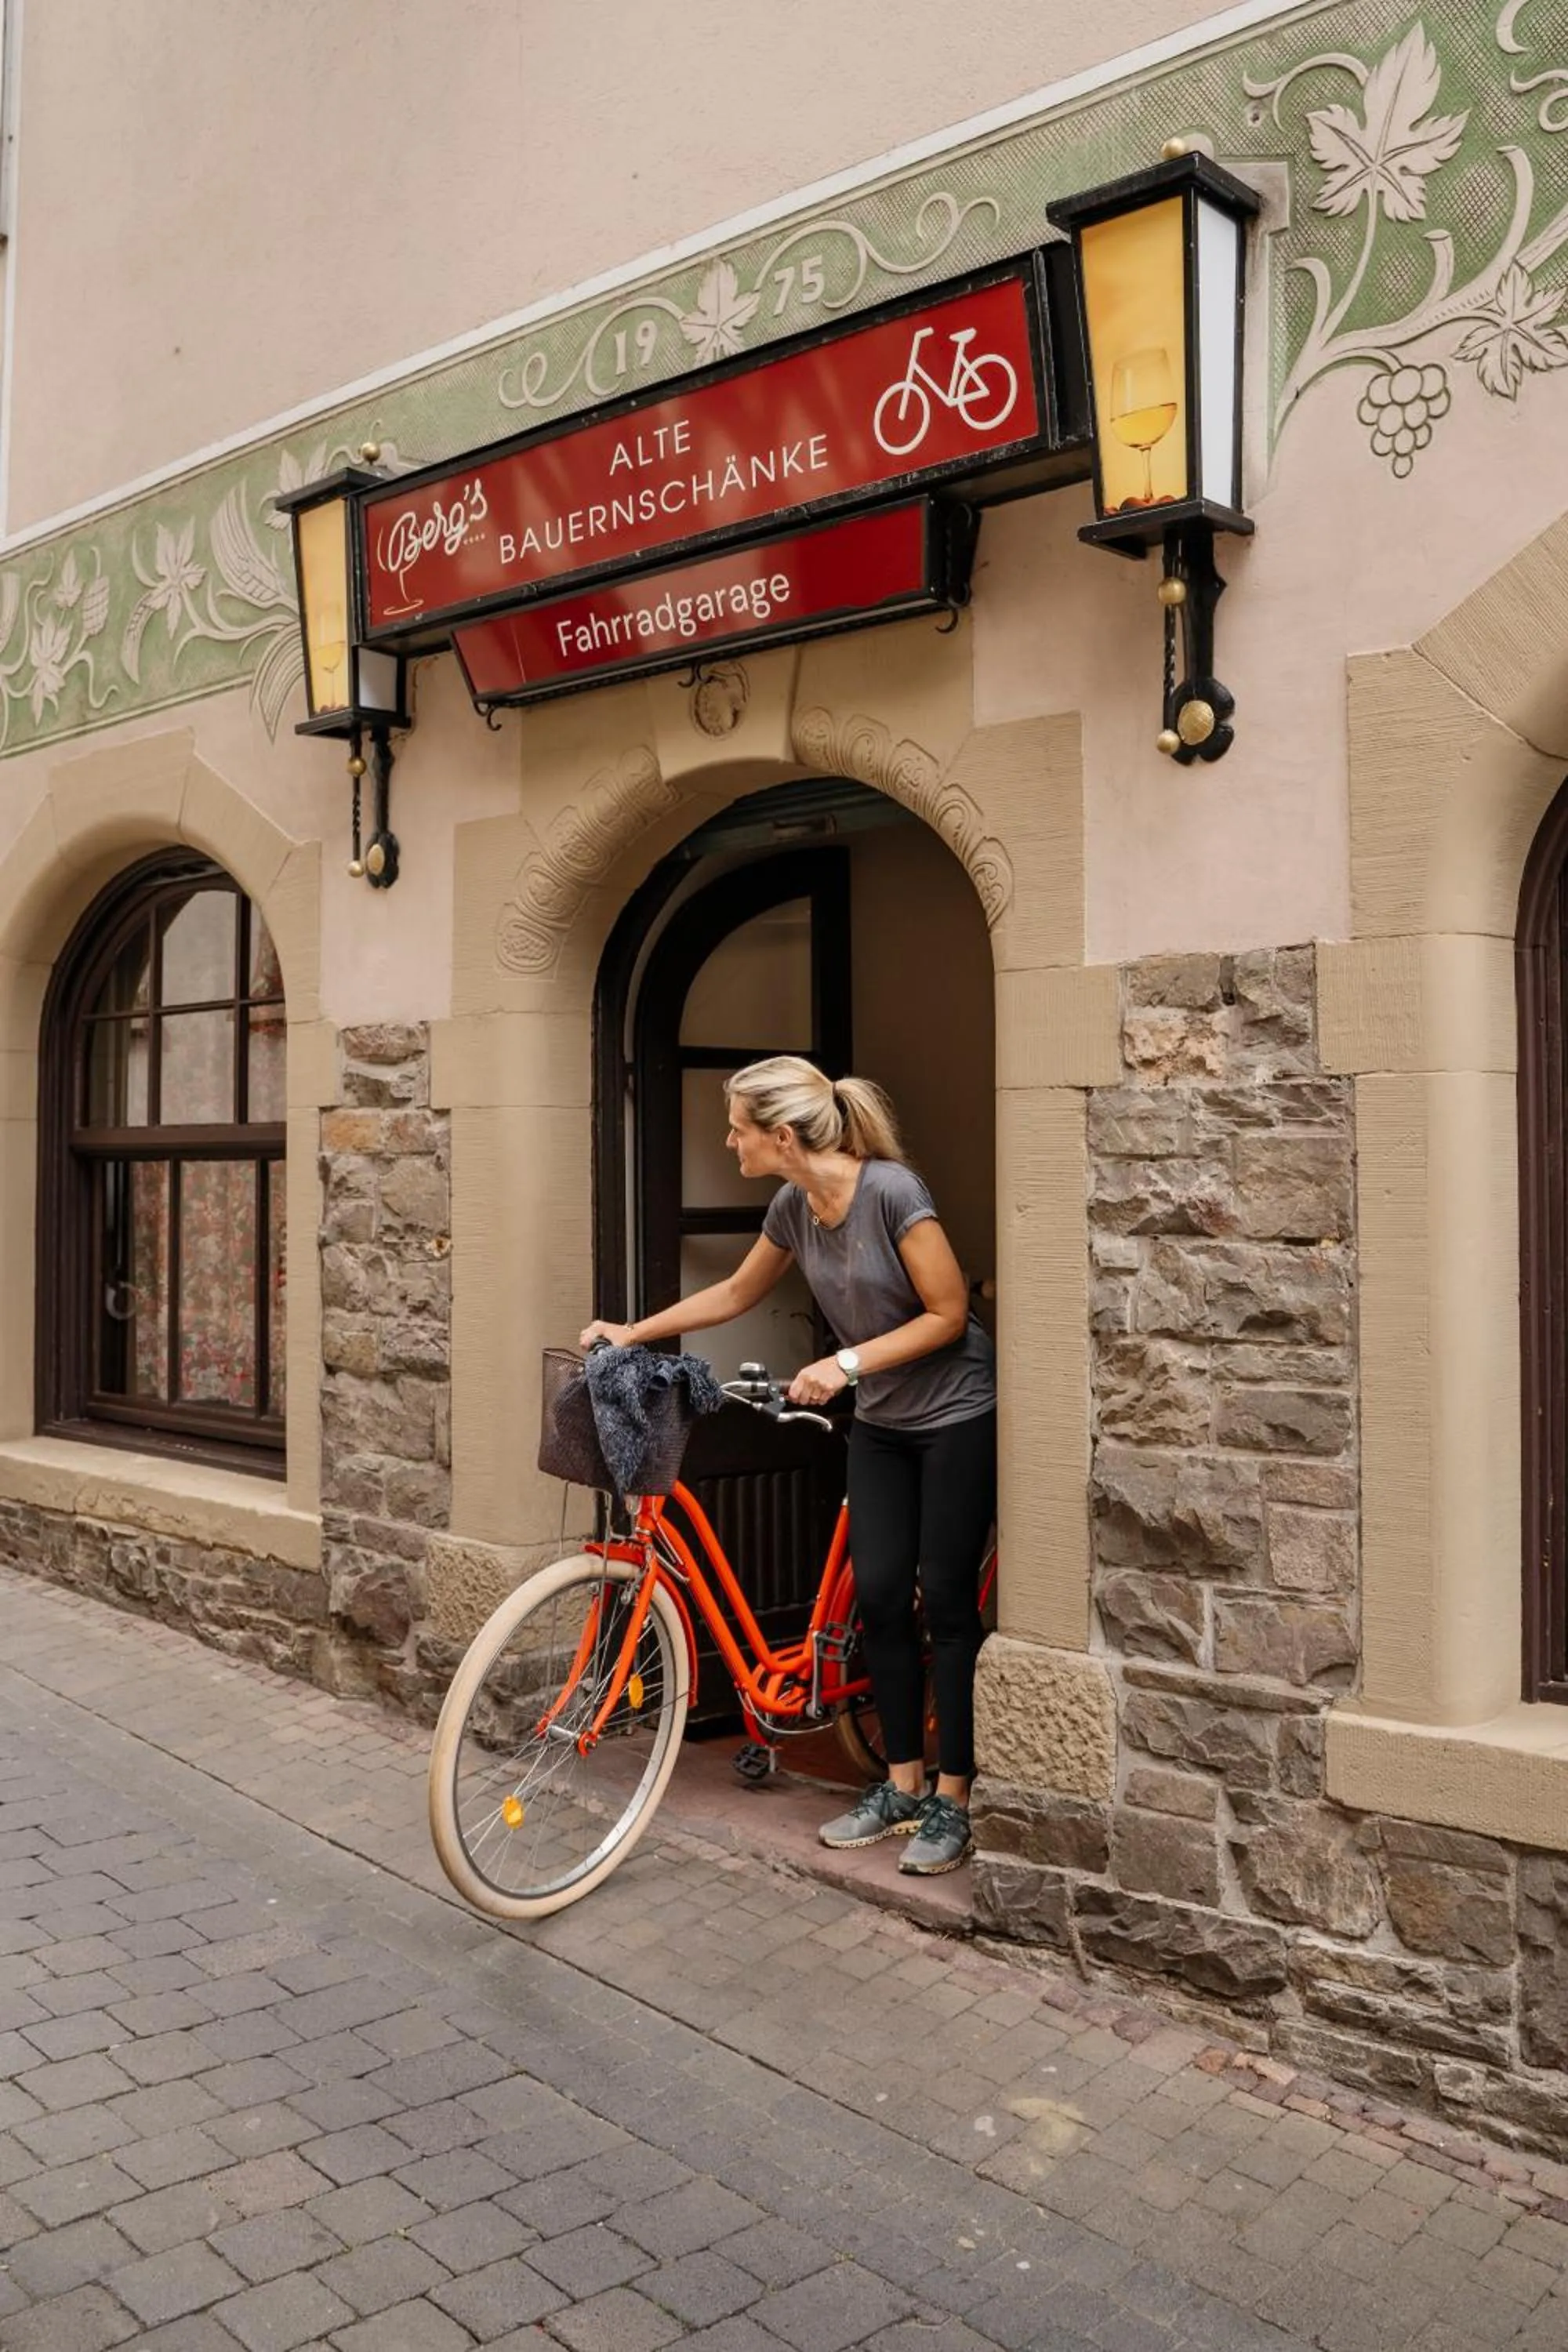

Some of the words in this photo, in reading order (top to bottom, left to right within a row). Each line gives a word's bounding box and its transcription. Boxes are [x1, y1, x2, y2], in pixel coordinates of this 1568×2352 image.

[615, 320, 659, 376] 19
[773, 254, 824, 317] 75
[609, 420, 691, 476] ALTE
[387, 478, 488, 572] Berg's
[499, 434, 829, 564] BAUERNSCHÄNKE
[557, 573, 790, 657] Fahrradgarage
